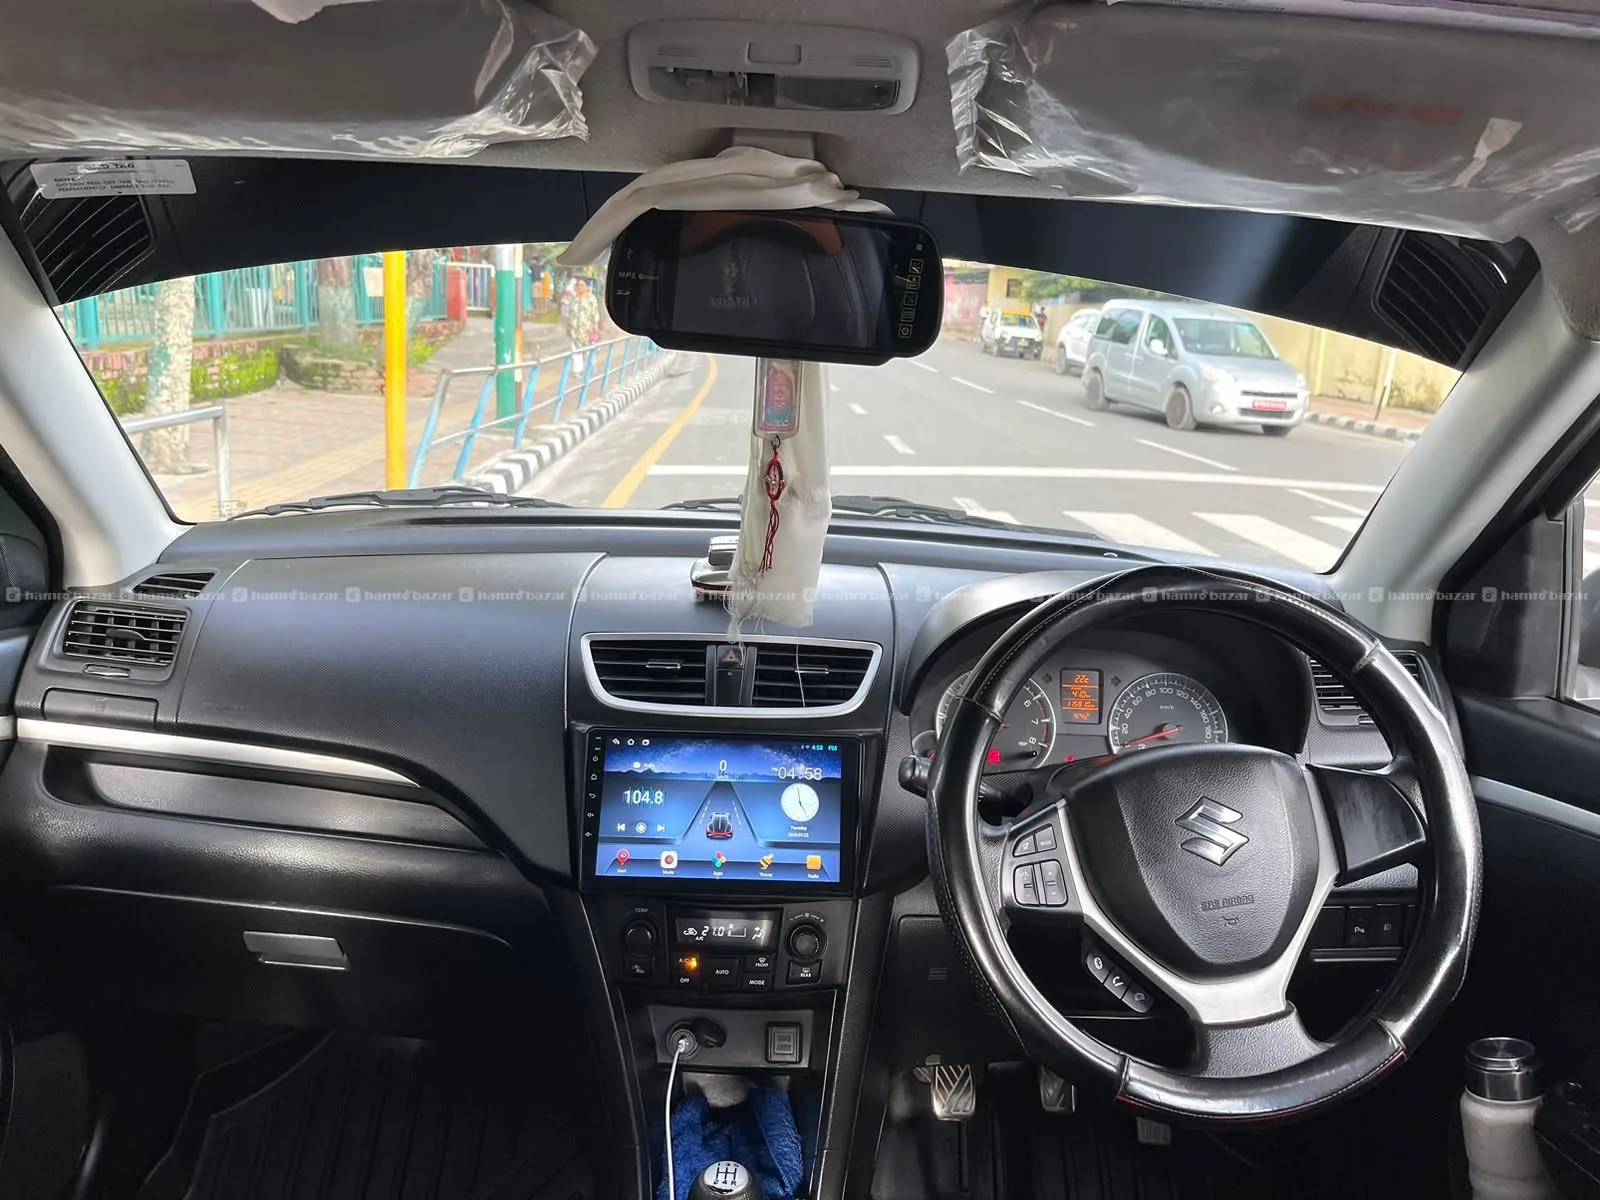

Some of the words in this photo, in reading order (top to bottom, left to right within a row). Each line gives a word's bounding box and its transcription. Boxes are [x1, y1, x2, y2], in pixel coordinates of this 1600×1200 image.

[1146, 688, 1157, 697] 80
[1159, 687, 1174, 695] 100
[1176, 689, 1189, 699] 120
[1124, 708, 1133, 719] 40
[1122, 723, 1129, 735] 20
[1029, 736, 1037, 745] 8
[719, 759, 728, 772] 0
[778, 766, 823, 780] 04:58
[624, 789, 664, 805] 104.8
